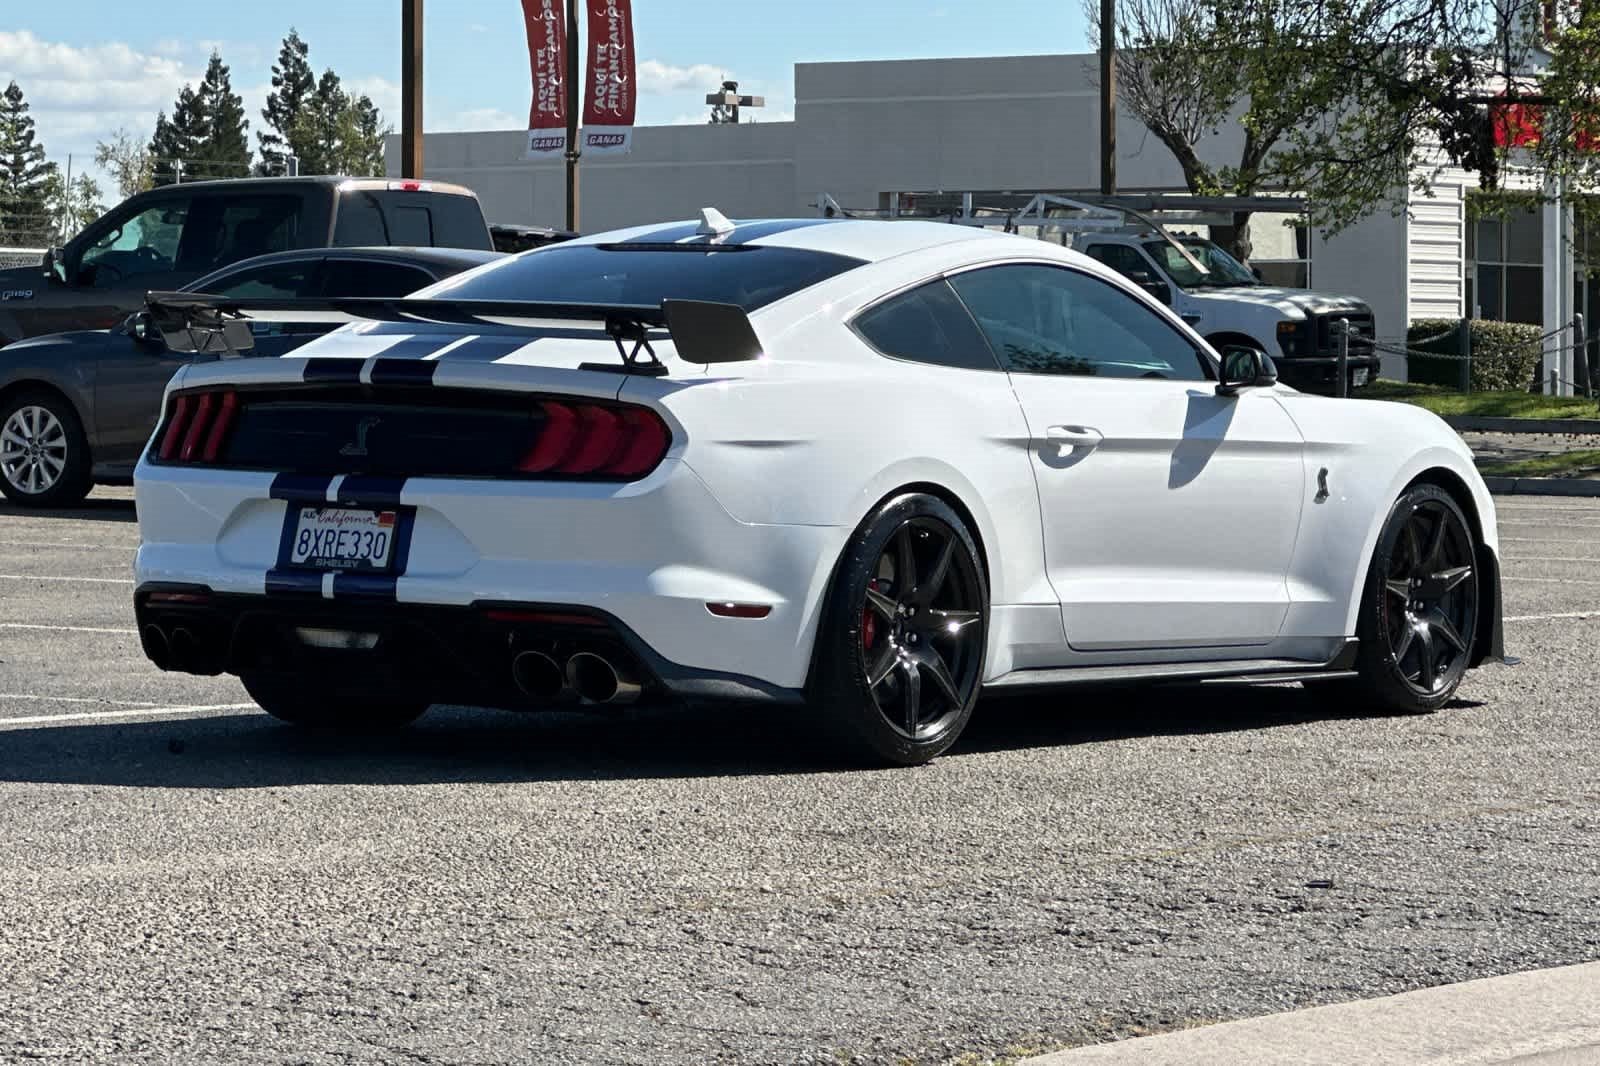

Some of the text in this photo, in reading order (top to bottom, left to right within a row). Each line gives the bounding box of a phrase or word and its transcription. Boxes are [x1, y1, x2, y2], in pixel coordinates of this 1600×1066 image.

[537, 47, 546, 67] TE
[597, 42, 608, 63] TE
[606, 0, 620, 110] FINANCIAMOS
[533, 137, 563, 148] GANAS
[589, 135, 624, 144] GANAS
[319, 510, 374, 527] California
[297, 528, 387, 560] 8XRE330
